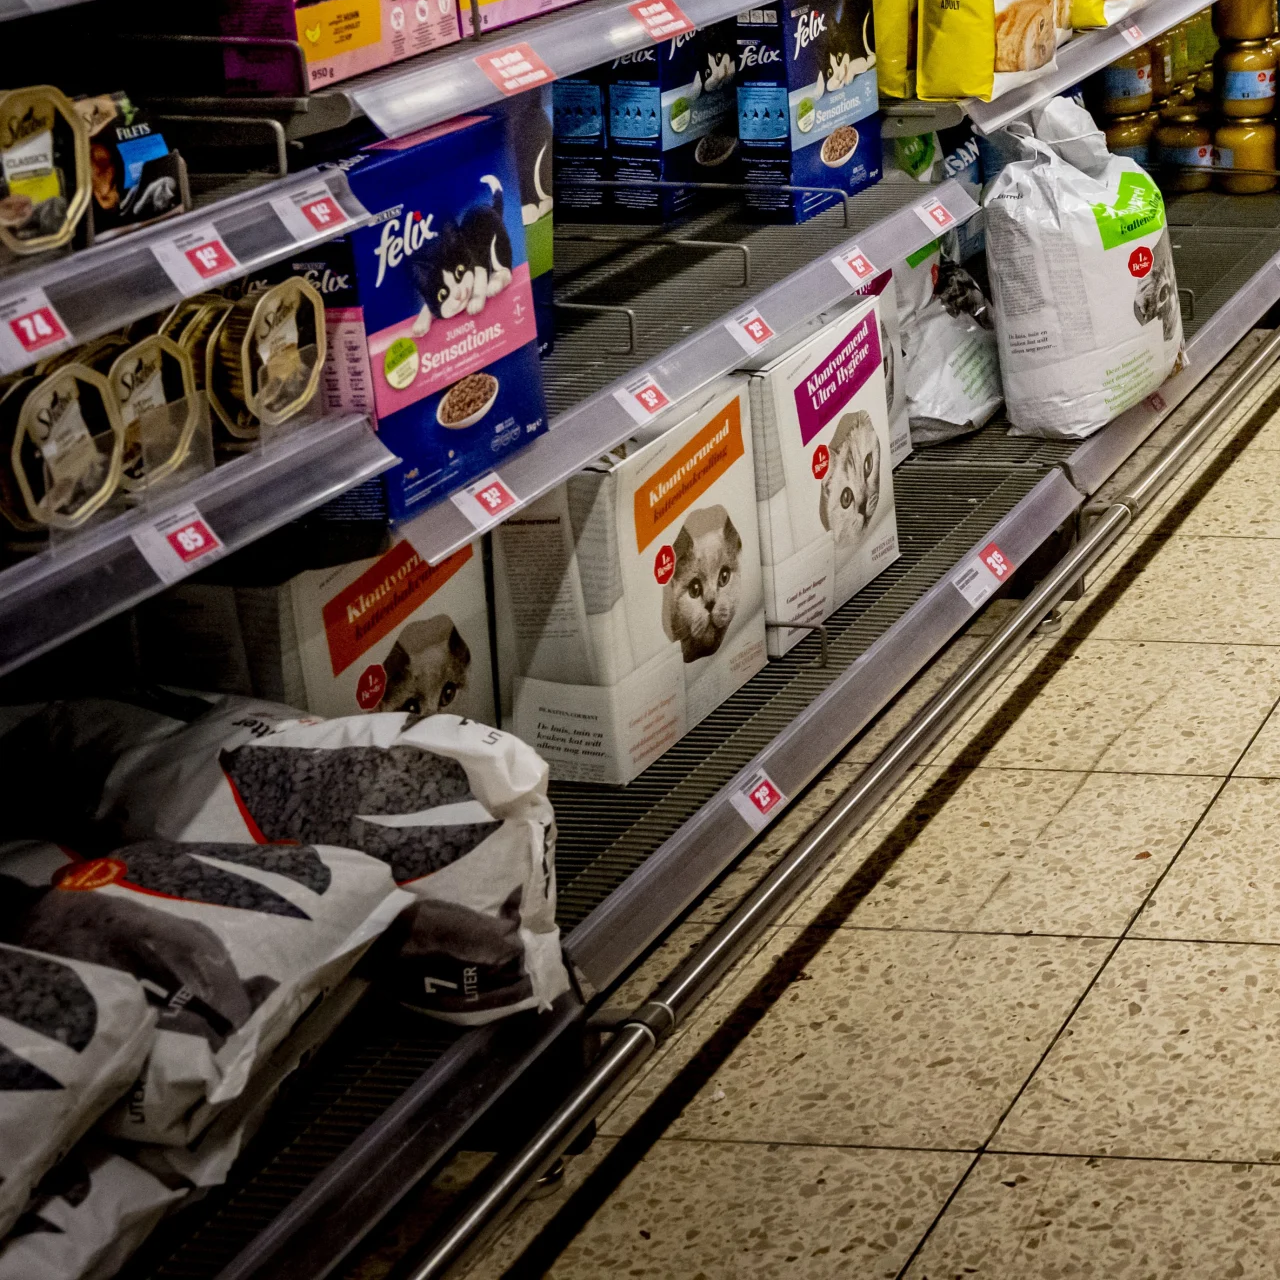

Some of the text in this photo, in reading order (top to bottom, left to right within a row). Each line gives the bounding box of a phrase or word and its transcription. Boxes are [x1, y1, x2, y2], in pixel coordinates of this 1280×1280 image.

[941, 0, 960, 10] ADULT
[794, 10, 827, 61] felix
[738, 46, 782, 71] felix
[312, 68, 329, 81] 950
[116, 122, 151, 141] FILETS
[375, 210, 438, 287] felix
[18, 313, 53, 343] 74
[445, 321, 476, 340] JUNIOR
[806, 321, 869, 398] Klontvormend
[811, 342, 870, 412] Ultra Hygiëne
[649, 419, 730, 508] Klontvormend
[177, 526, 204, 551] 85
[425, 976, 458, 995] 7
[463, 966, 478, 1003] LITER
